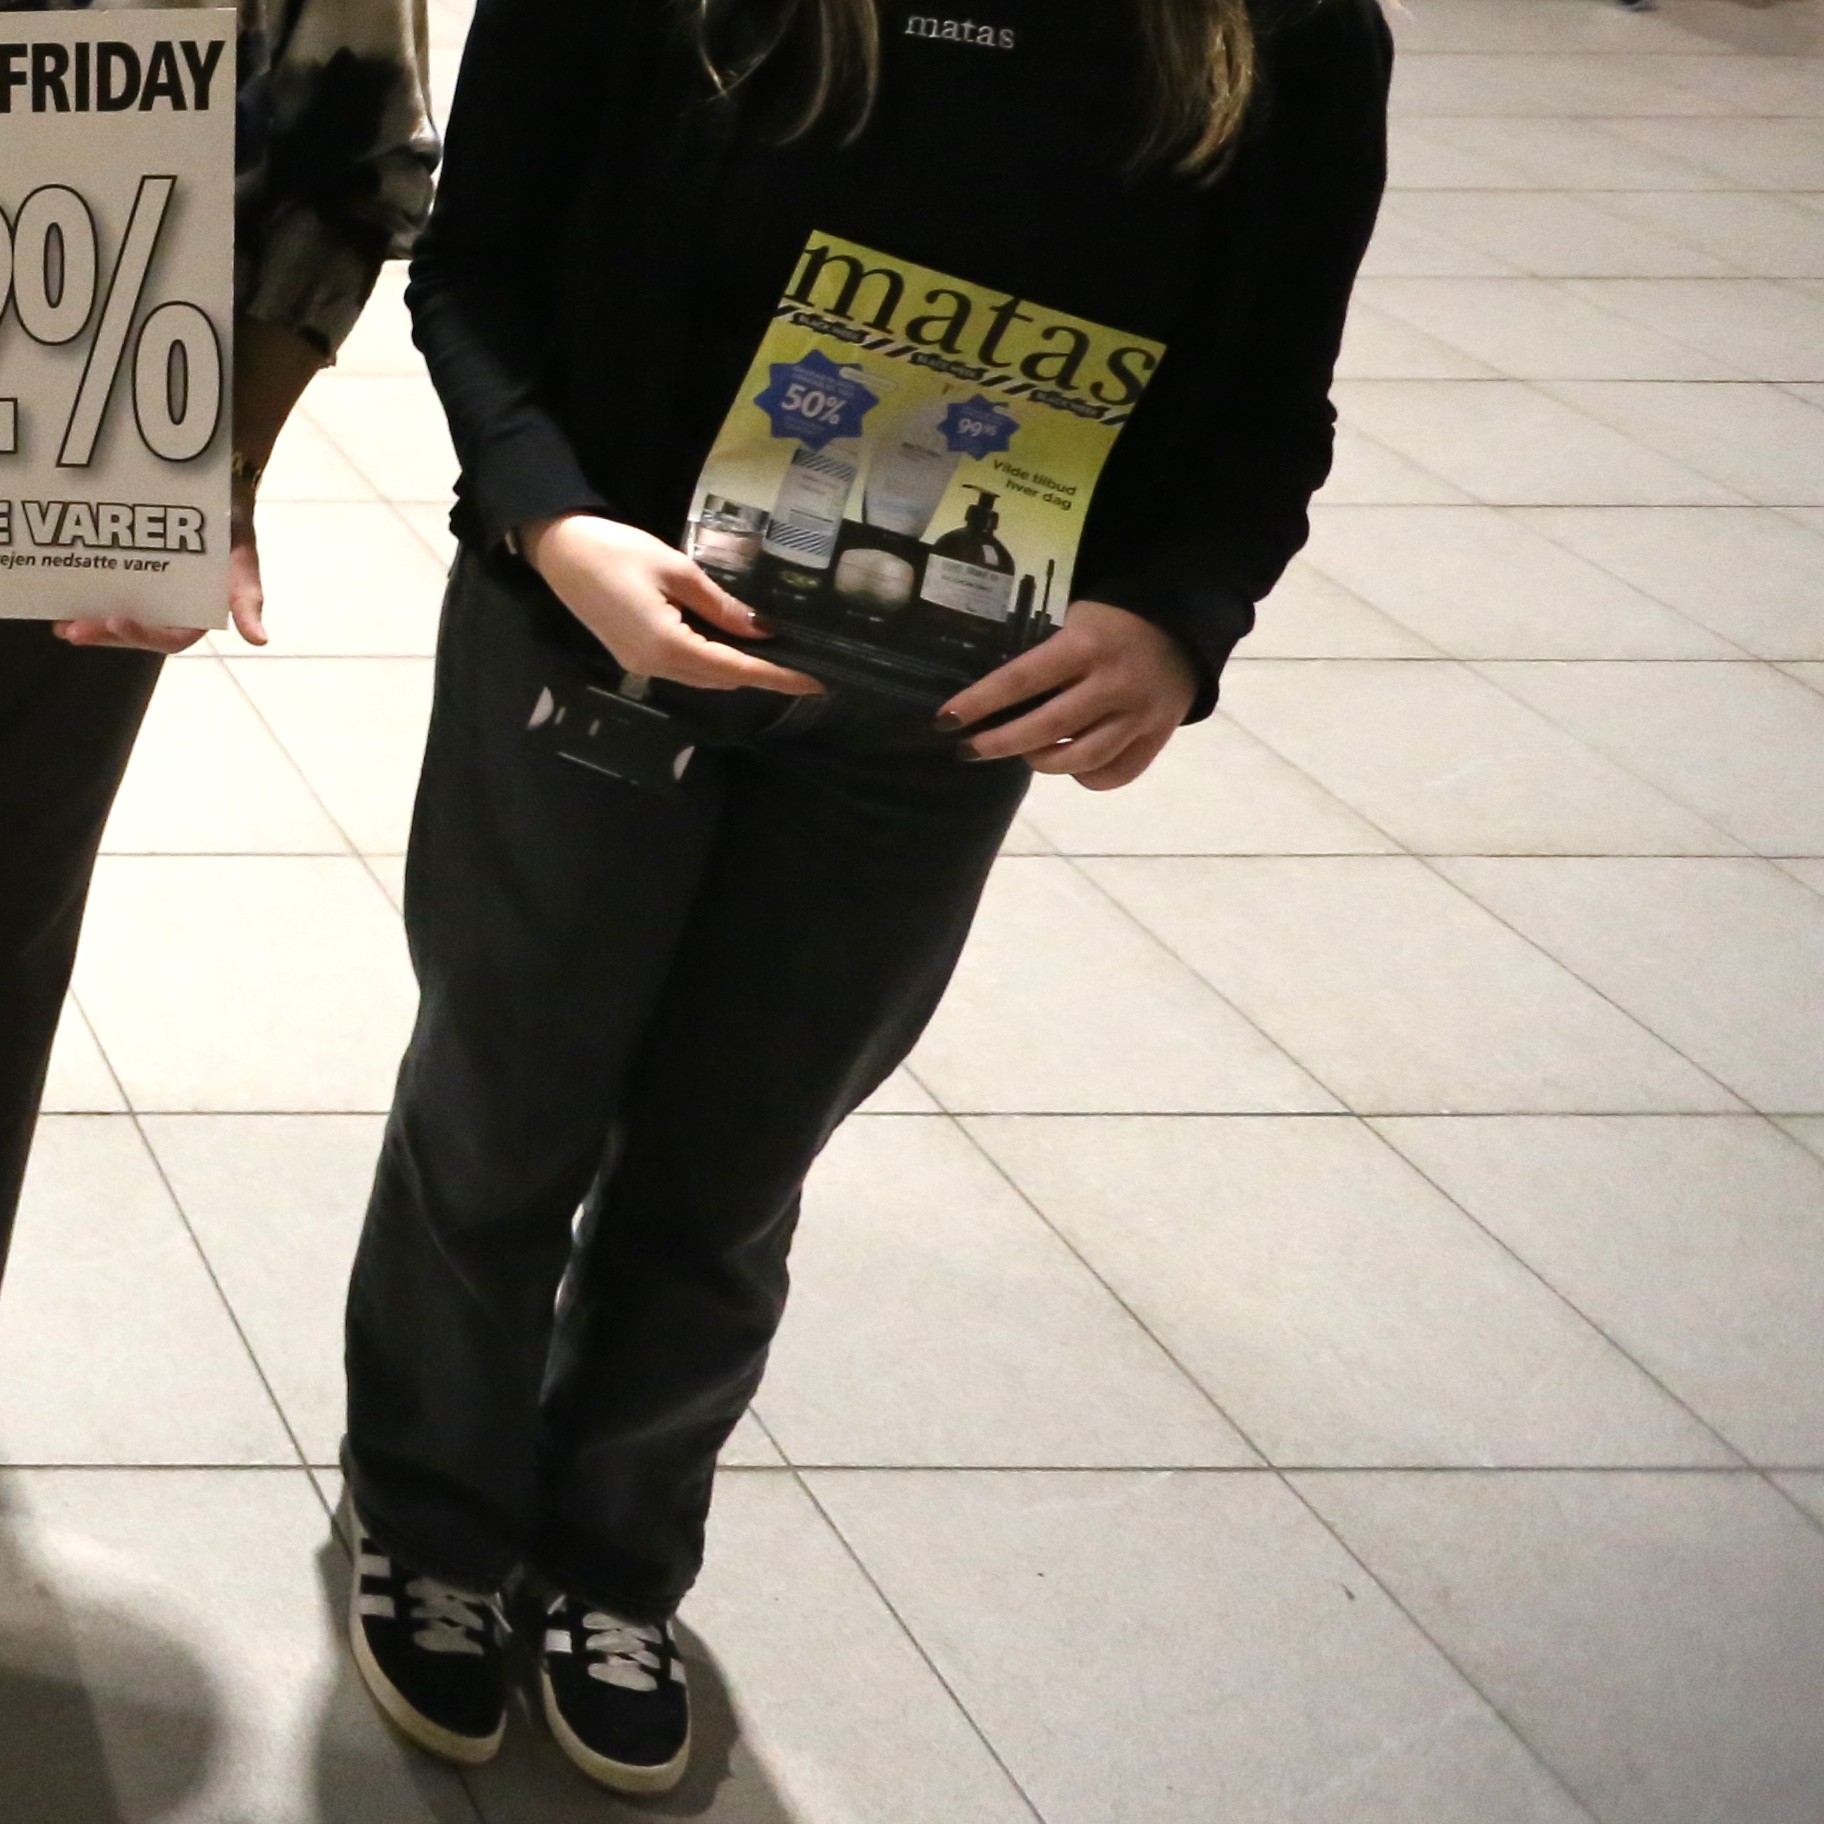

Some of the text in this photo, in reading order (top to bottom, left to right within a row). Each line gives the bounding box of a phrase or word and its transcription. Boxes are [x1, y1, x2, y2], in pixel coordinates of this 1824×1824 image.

[905, 13, 1016, 49] matas
[784, 245, 1157, 407] matas
[780, 384, 847, 426] 50%
[993, 458, 1077, 496] Vilde tilbud
[1005, 478, 1073, 511] hver dag
[22, 499, 206, 552] VARER
[42, 551, 117, 570] nedsatte
[124, 558, 170, 573] varer
